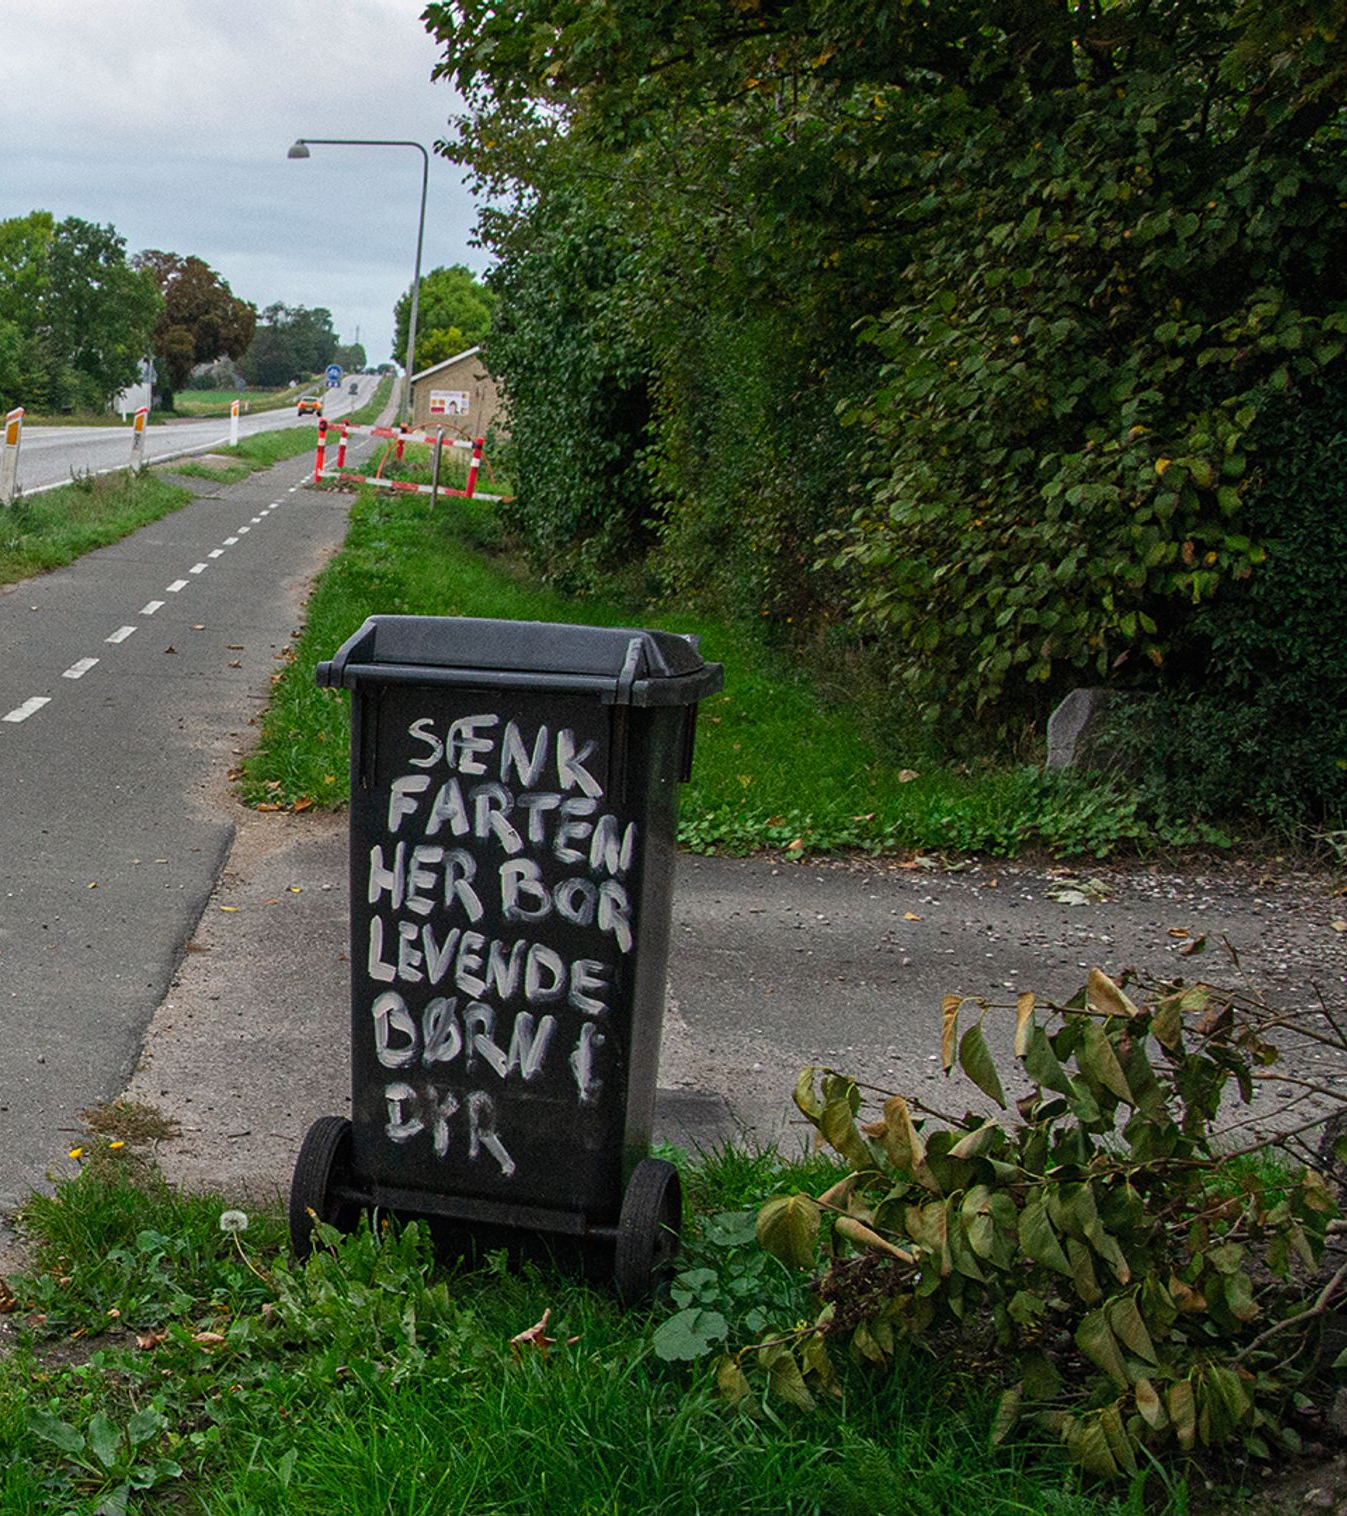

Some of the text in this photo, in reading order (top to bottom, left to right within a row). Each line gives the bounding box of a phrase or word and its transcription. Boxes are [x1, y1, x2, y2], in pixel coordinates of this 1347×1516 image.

[408, 714, 603, 798] SÆNK
[388, 774, 636, 876] FARTEN
[368, 840, 633, 953] HER BOR
[368, 914, 609, 1016] LEVENDE
[371, 991, 556, 1080] BØRN
[384, 1082, 516, 1177] DYR
